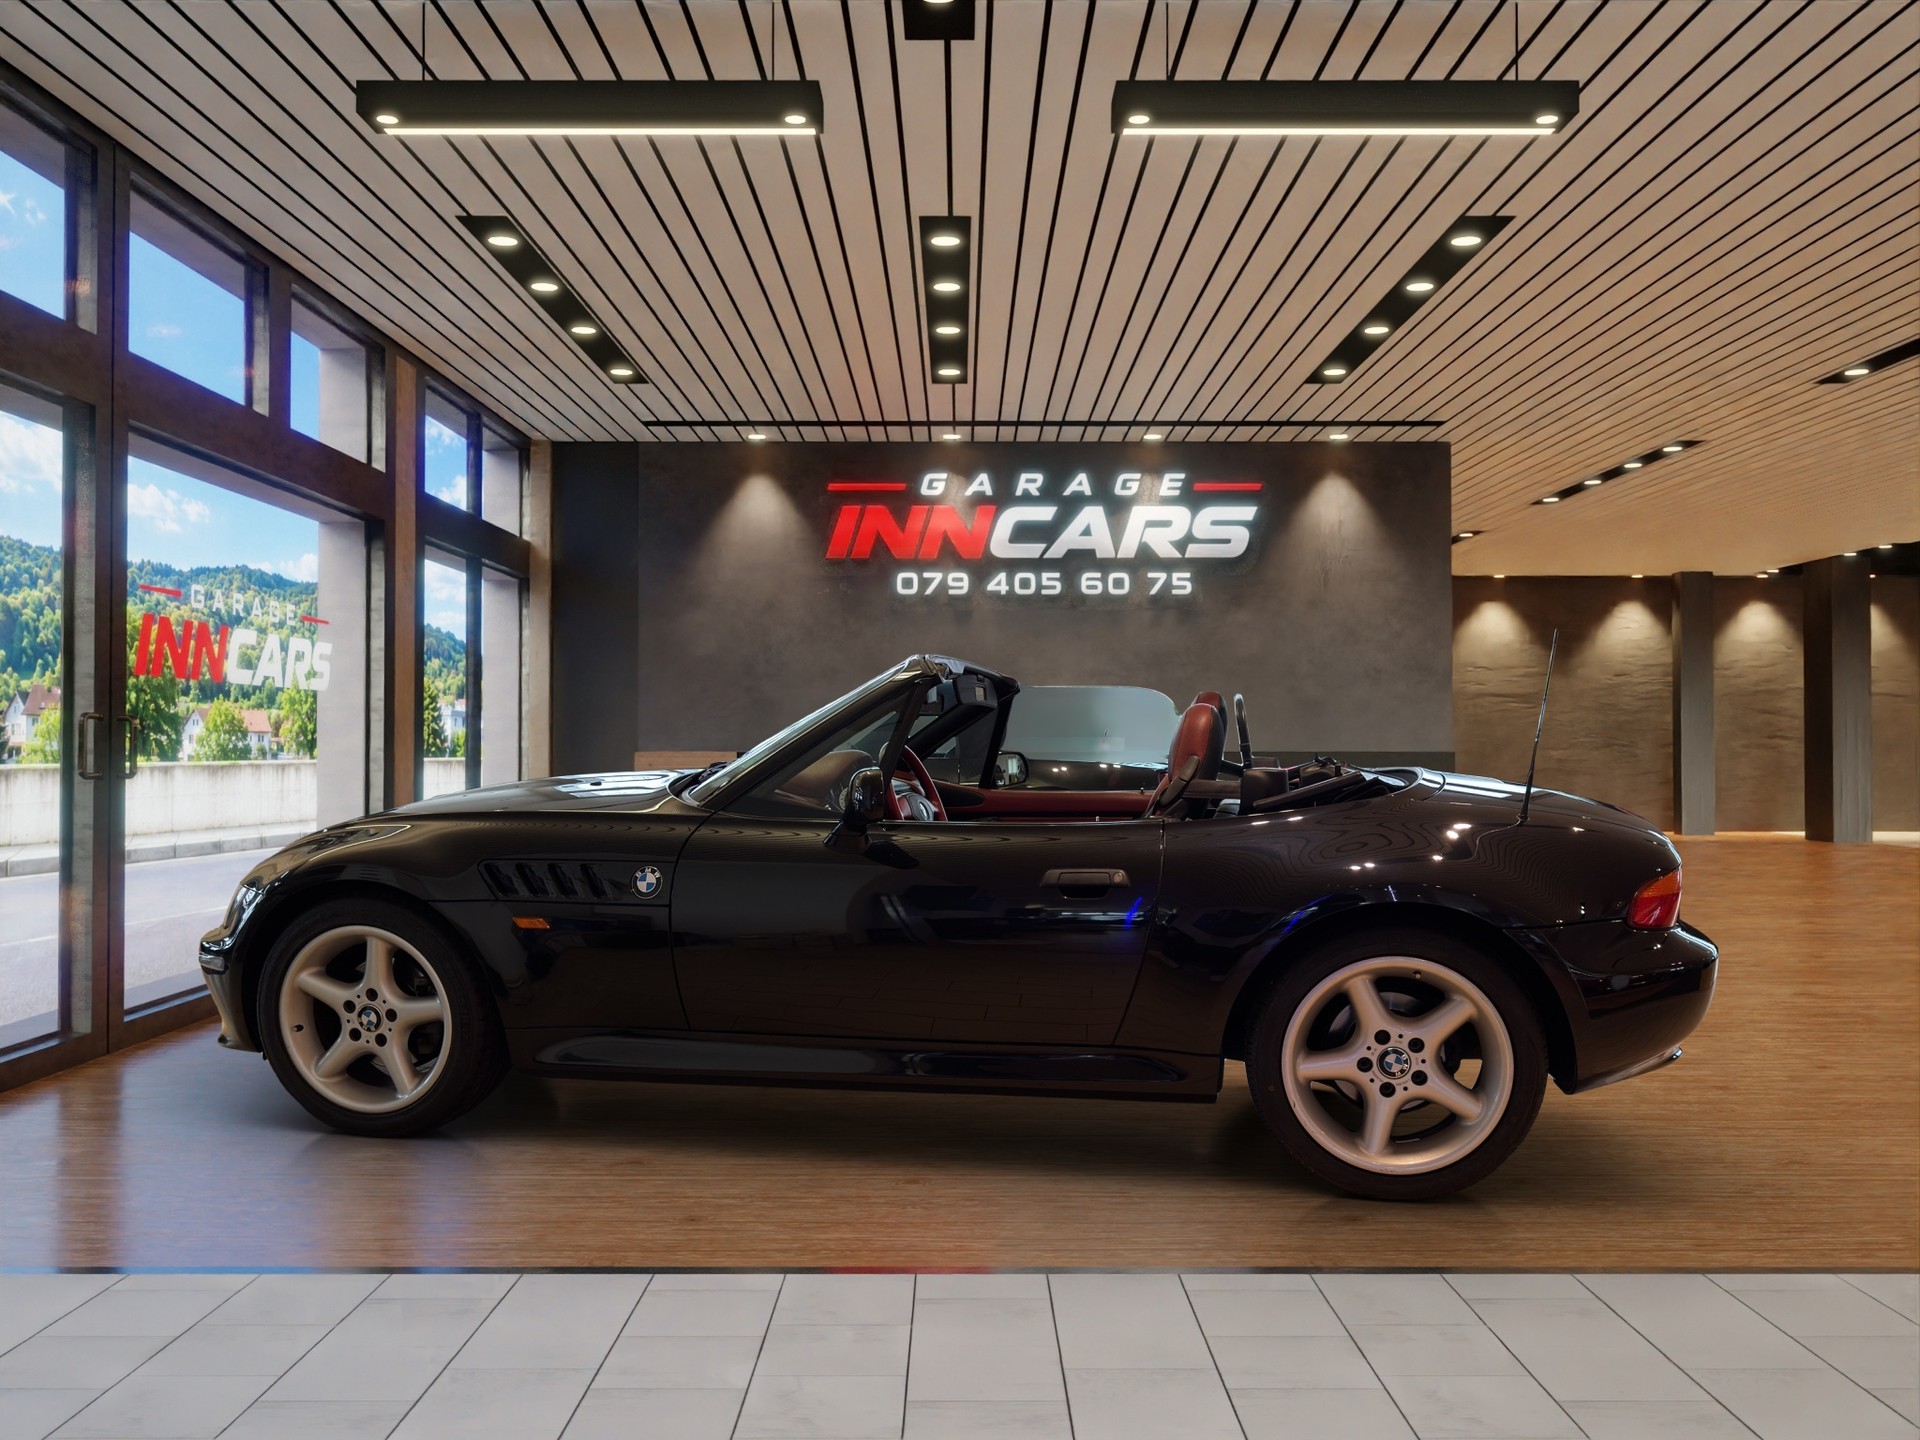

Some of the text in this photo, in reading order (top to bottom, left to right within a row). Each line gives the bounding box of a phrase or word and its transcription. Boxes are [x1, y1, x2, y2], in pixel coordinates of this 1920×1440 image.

[920, 472, 1186, 496] GARAGE
[825, 505, 1258, 559] INNCARS
[896, 572, 1192, 595] 079 405 60 75
[190, 584, 296, 626] GARAGE
[133, 612, 333, 691] INNCARS
